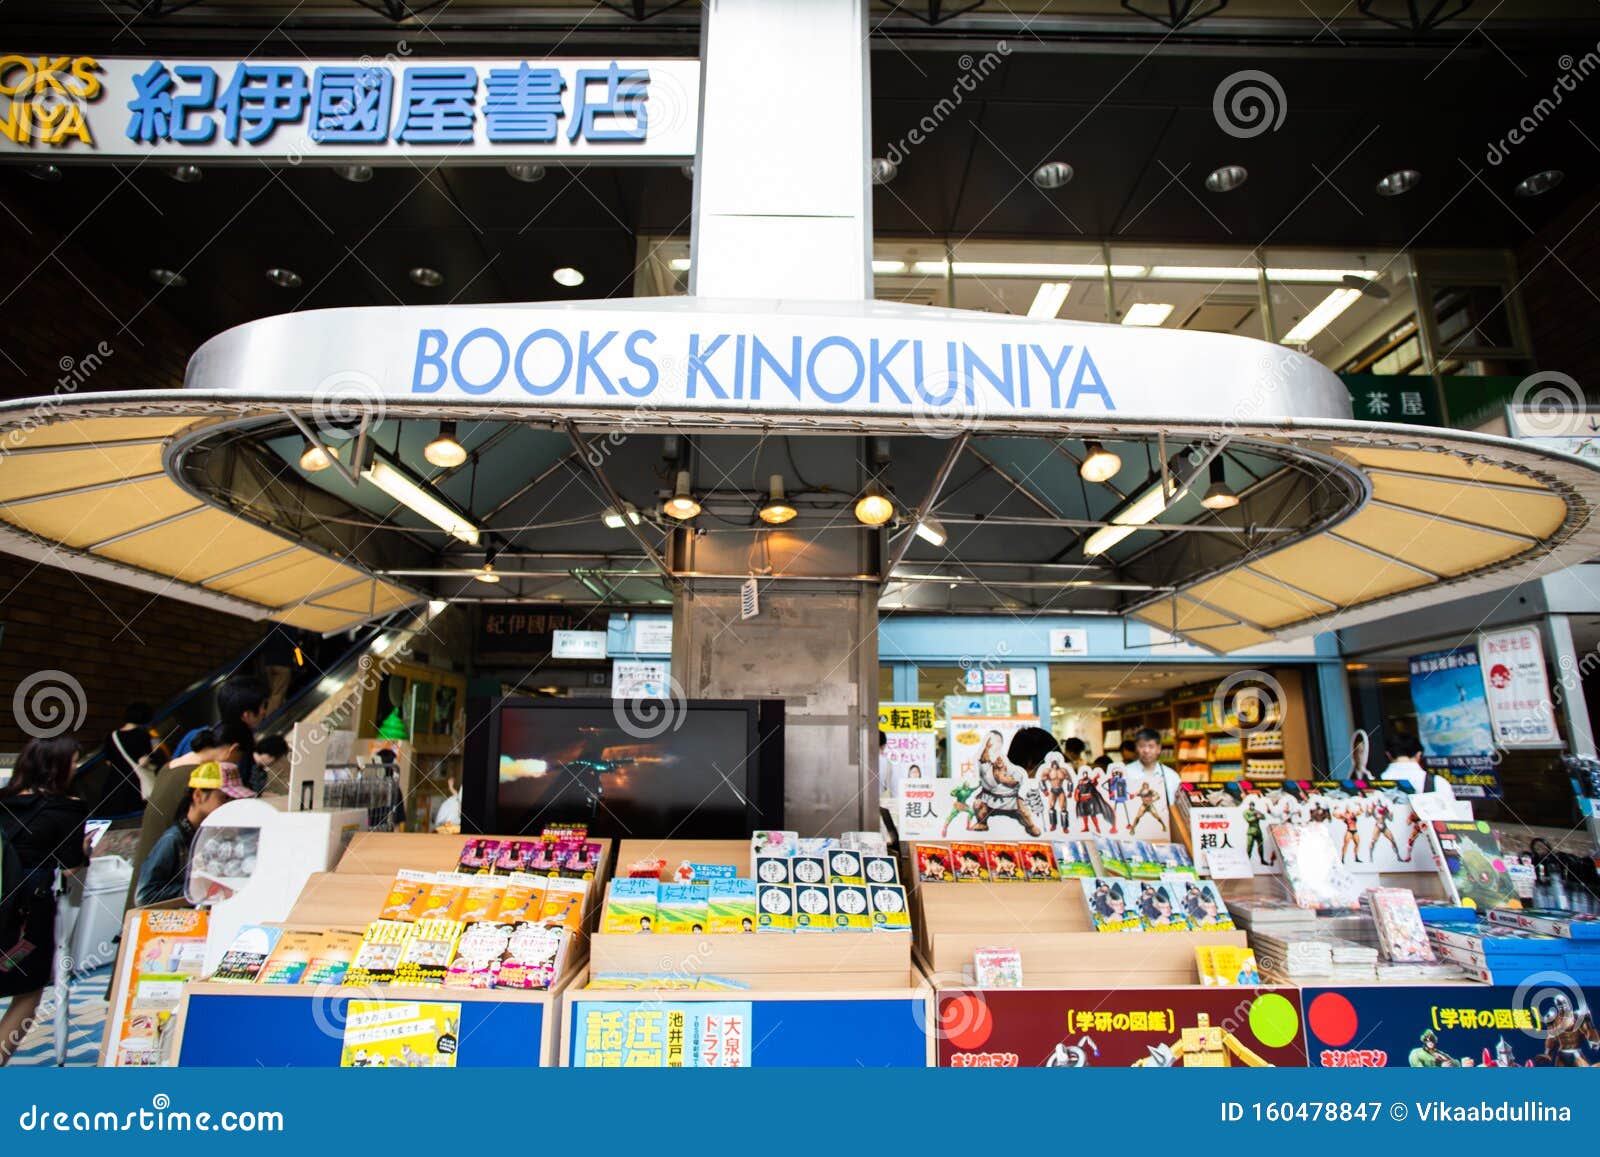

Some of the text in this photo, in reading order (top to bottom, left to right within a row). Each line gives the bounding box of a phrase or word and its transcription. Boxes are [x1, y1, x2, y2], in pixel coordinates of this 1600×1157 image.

[127, 60, 651, 146] 紀伊國屋書店
[411, 327, 1116, 411] BOOKS KINOKUNIYA
[905, 801, 938, 818] 超人
[1200, 833, 1233, 850] 超人
